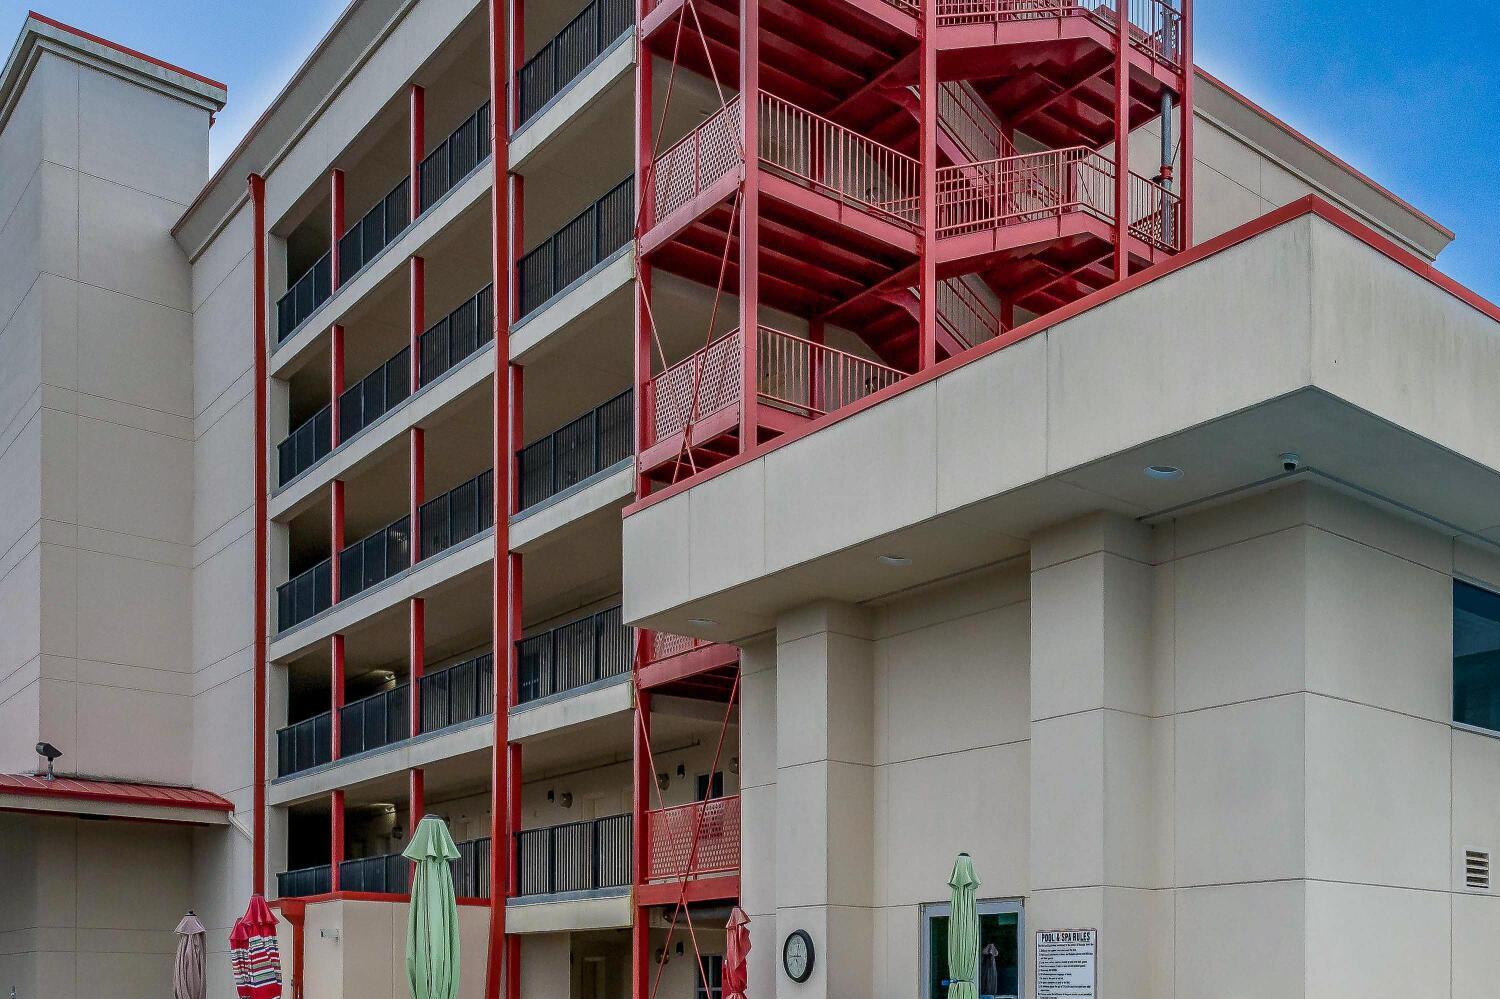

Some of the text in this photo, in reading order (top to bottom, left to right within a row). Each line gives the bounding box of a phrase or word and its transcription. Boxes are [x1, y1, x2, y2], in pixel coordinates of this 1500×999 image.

[1041, 932, 1091, 942] POOL & SPA RULES
